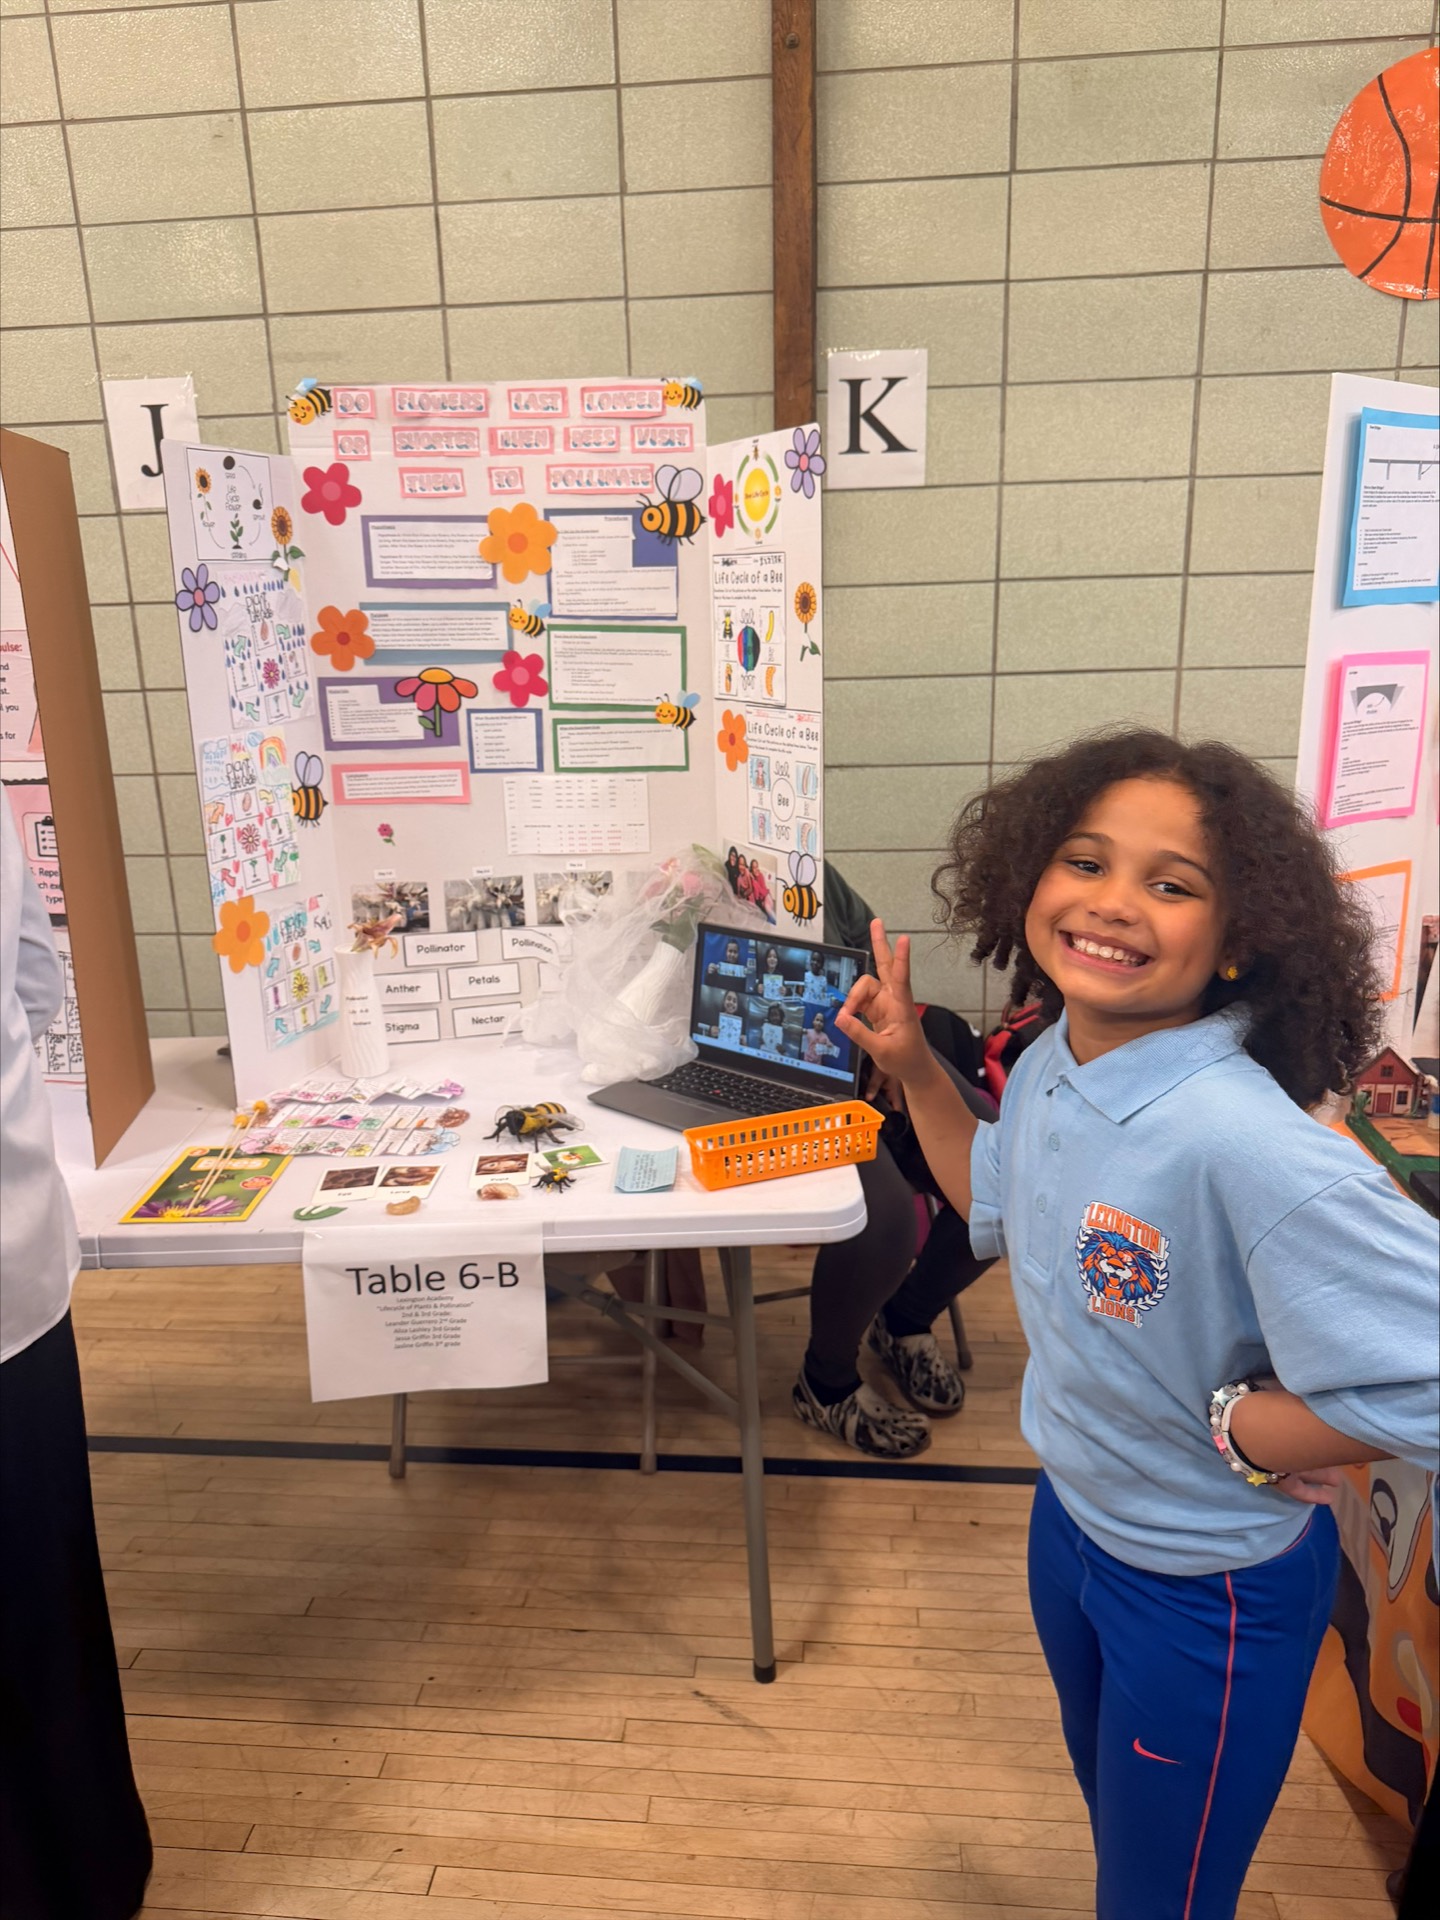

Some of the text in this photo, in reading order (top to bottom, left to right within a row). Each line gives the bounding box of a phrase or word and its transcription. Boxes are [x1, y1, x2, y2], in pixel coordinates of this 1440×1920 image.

[398, 392, 484, 411] FLOWERS
[513, 392, 561, 411] LAST
[586, 391, 661, 411] LONGER
[838, 376, 918, 455] K
[140, 403, 169, 477] J
[339, 436, 366, 454] OR
[396, 431, 478, 450] SHORTER
[636, 428, 689, 446] VISIT
[406, 474, 460, 493] THEM
[550, 468, 650, 487] POLLINATE
[714, 571, 729, 585] Life
[731, 571, 750, 585] Cycle
[751, 570, 761, 584] of
[770, 569, 783, 583] Bee
[5, 705, 19, 713] you
[748, 721, 763, 735] Life
[764, 723, 784, 738] Cycle
[786, 726, 797, 739] of
[806, 728, 819, 742] Bee
[777, 793, 789, 807] Bee
[416, 944, 466, 954] Pollinator
[385, 984, 421, 994] Anther
[468, 975, 501, 985] Petals
[385, 1022, 420, 1034] Stigma
[471, 1015, 505, 1025] Nectar
[1086, 1202, 1161, 1255] LEXINGTON
[345, 1261, 520, 1295] Table 6-B
[1091, 1295, 1137, 1323] LIONS
